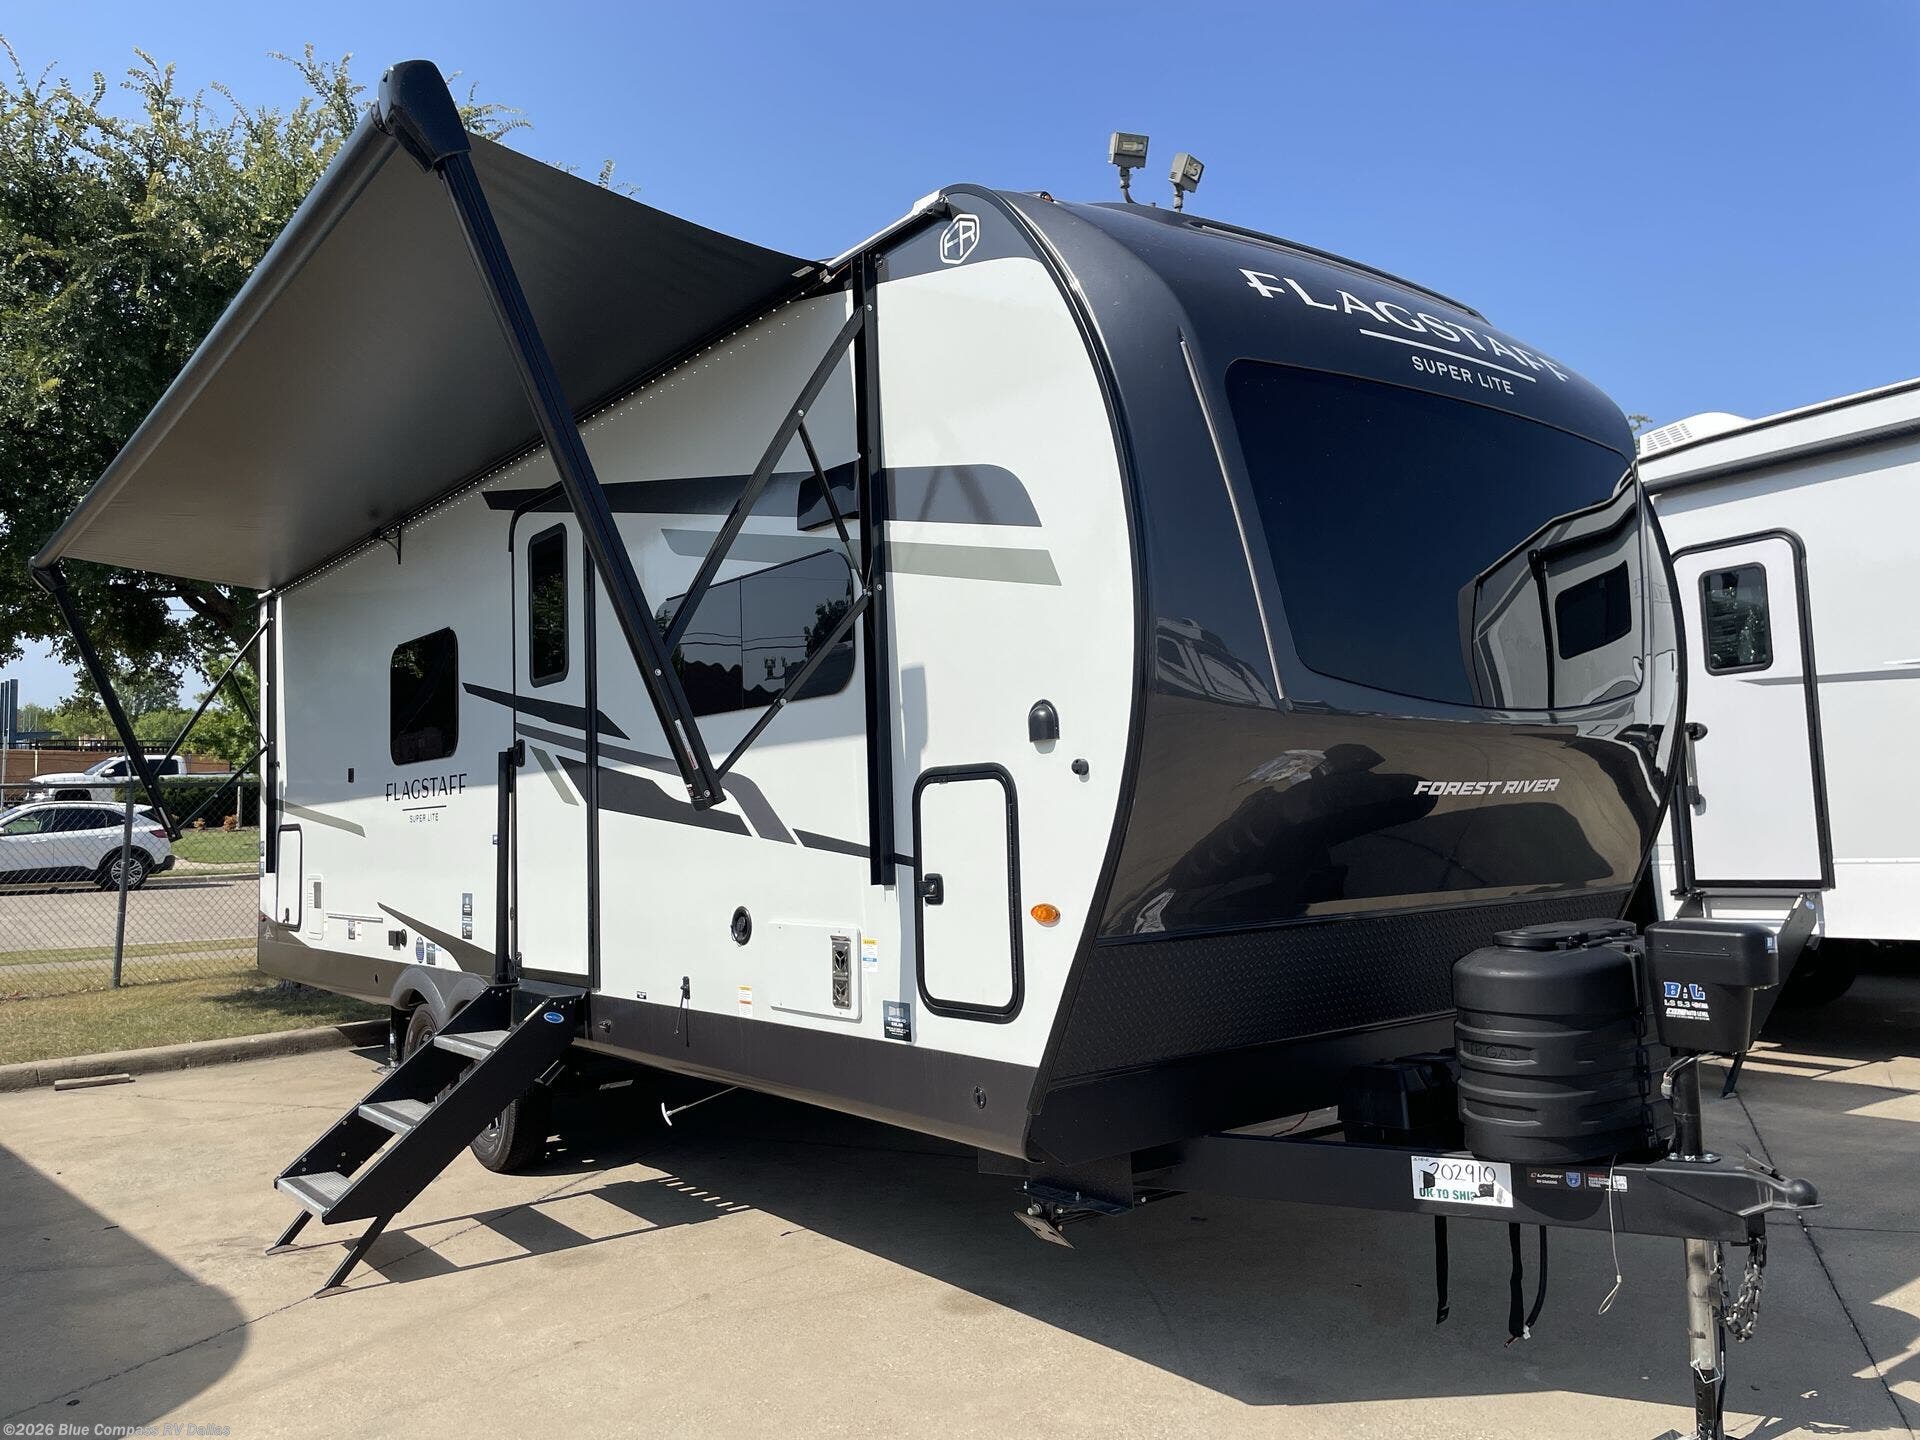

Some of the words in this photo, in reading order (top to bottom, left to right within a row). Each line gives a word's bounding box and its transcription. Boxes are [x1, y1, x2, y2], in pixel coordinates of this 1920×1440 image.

[1238, 267, 1570, 384] FLAGSTAFF
[1411, 354, 1474, 385] SUPER
[1479, 372, 1515, 396] LITE
[385, 773, 468, 802] FLAGSTAFF
[1413, 780, 1502, 796] FOREST
[1502, 778, 1560, 795] RIVER
[1428, 1161, 1497, 1183] 202910
[1436, 1188, 1449, 1199] TO
